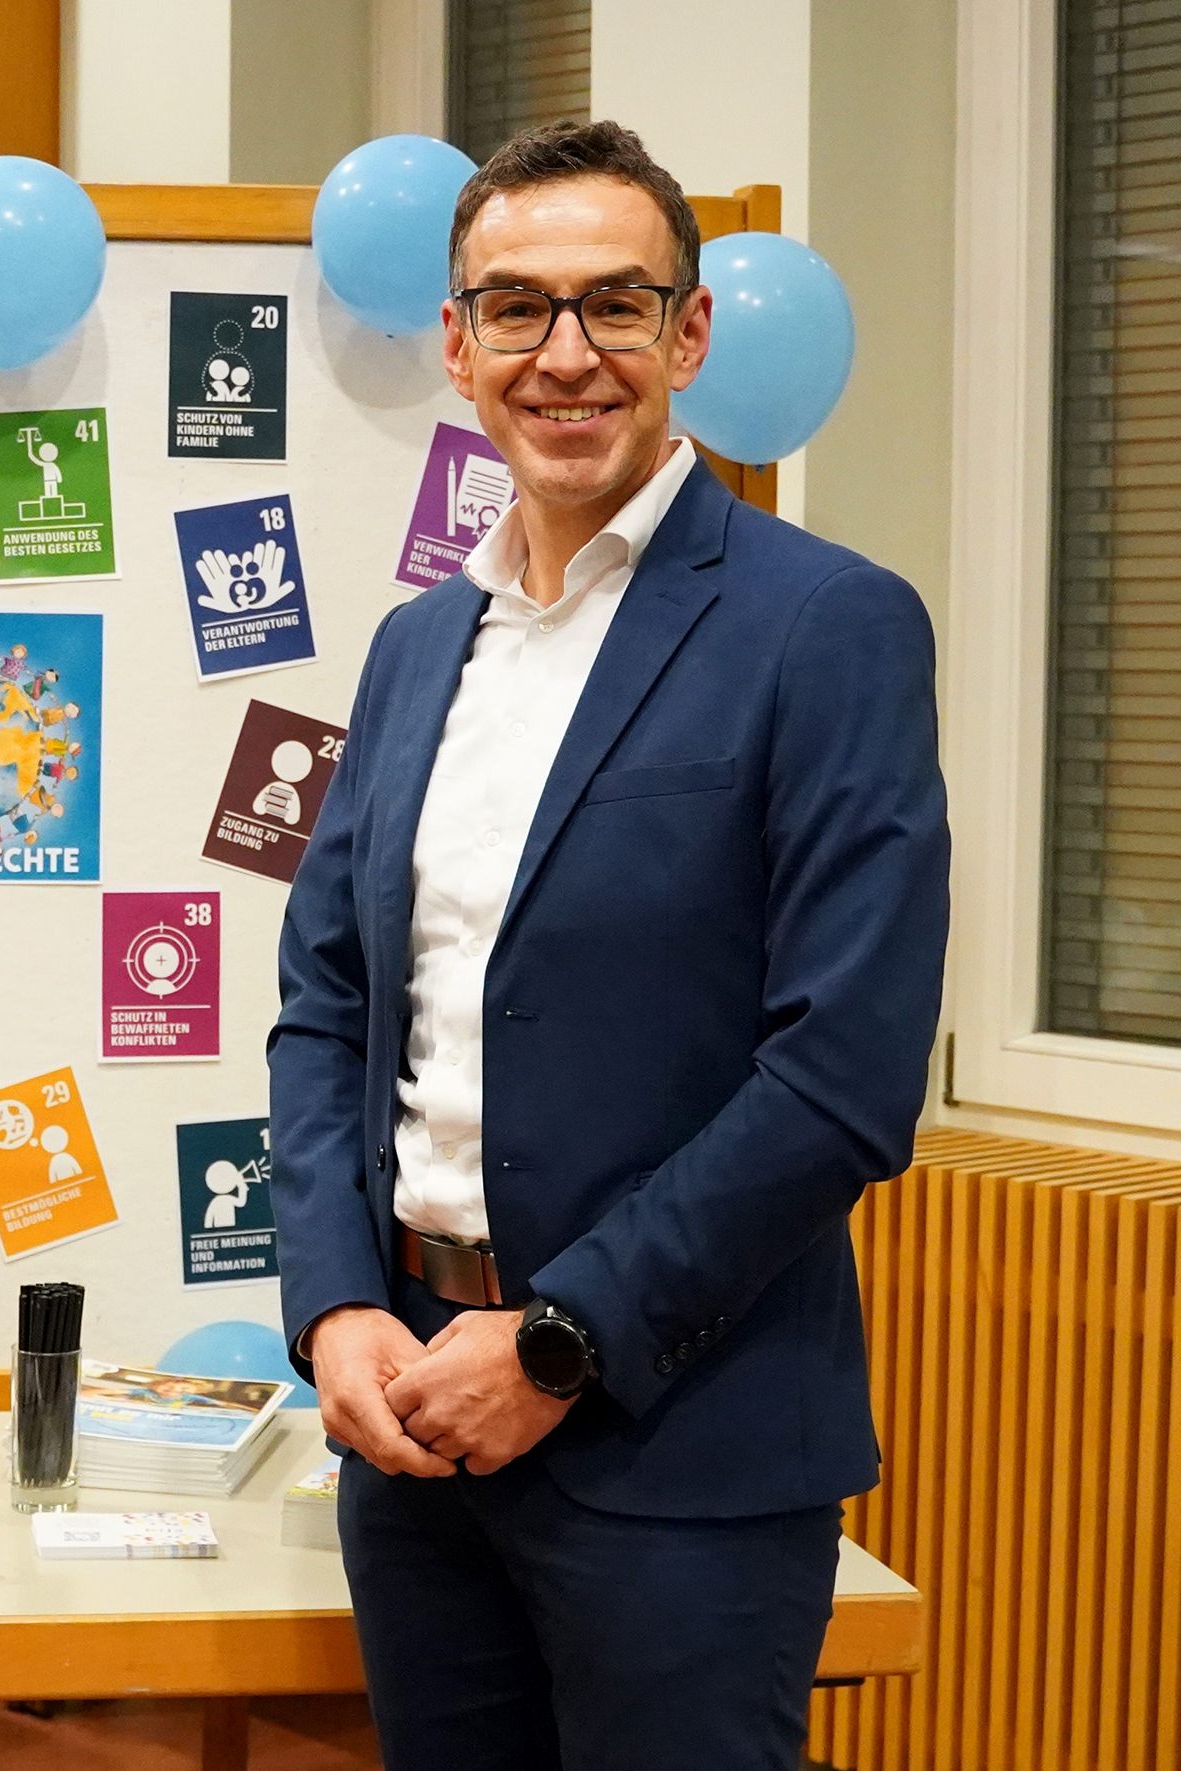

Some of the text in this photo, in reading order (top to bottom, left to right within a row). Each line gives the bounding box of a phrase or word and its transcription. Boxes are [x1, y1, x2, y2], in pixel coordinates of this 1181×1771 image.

[251, 305, 279, 329] 20
[176, 412, 242, 424] SCHUTZ VON
[75, 419, 99, 442] 41
[176, 424, 254, 437] KINDERN OHNE
[176, 436, 219, 448] FAMILIE
[259, 506, 286, 532] 18
[3, 529, 99, 545] ANWENDUNG DES
[4, 541, 102, 557] BESTEN GESETZES
[410, 550, 431, 566] DER
[413, 539, 468, 564] VERWIRKL
[202, 614, 300, 640] VERANTWORTUNG
[204, 632, 266, 653] DER ELTERN
[317, 735, 346, 763] 28
[216, 827, 263, 851] BILDUNG
[219, 815, 280, 844] ZUGANG ZU
[183, 902, 212, 927] 38
[110, 1011, 167, 1023] SCHUTZ IN
[110, 1023, 190, 1035] BEWAFFNETEN
[110, 1035, 177, 1046] KONFLIKTEN
[41, 1080, 70, 1109] 29
[2, 1187, 82, 1223] BESTMÖGLICHE
[5, 1209, 53, 1233] BILDUNG
[190, 1234, 272, 1252] FREIE MEINUNG
[190, 1251, 215, 1263] UND
[191, 1257, 266, 1274] INFORMATION
